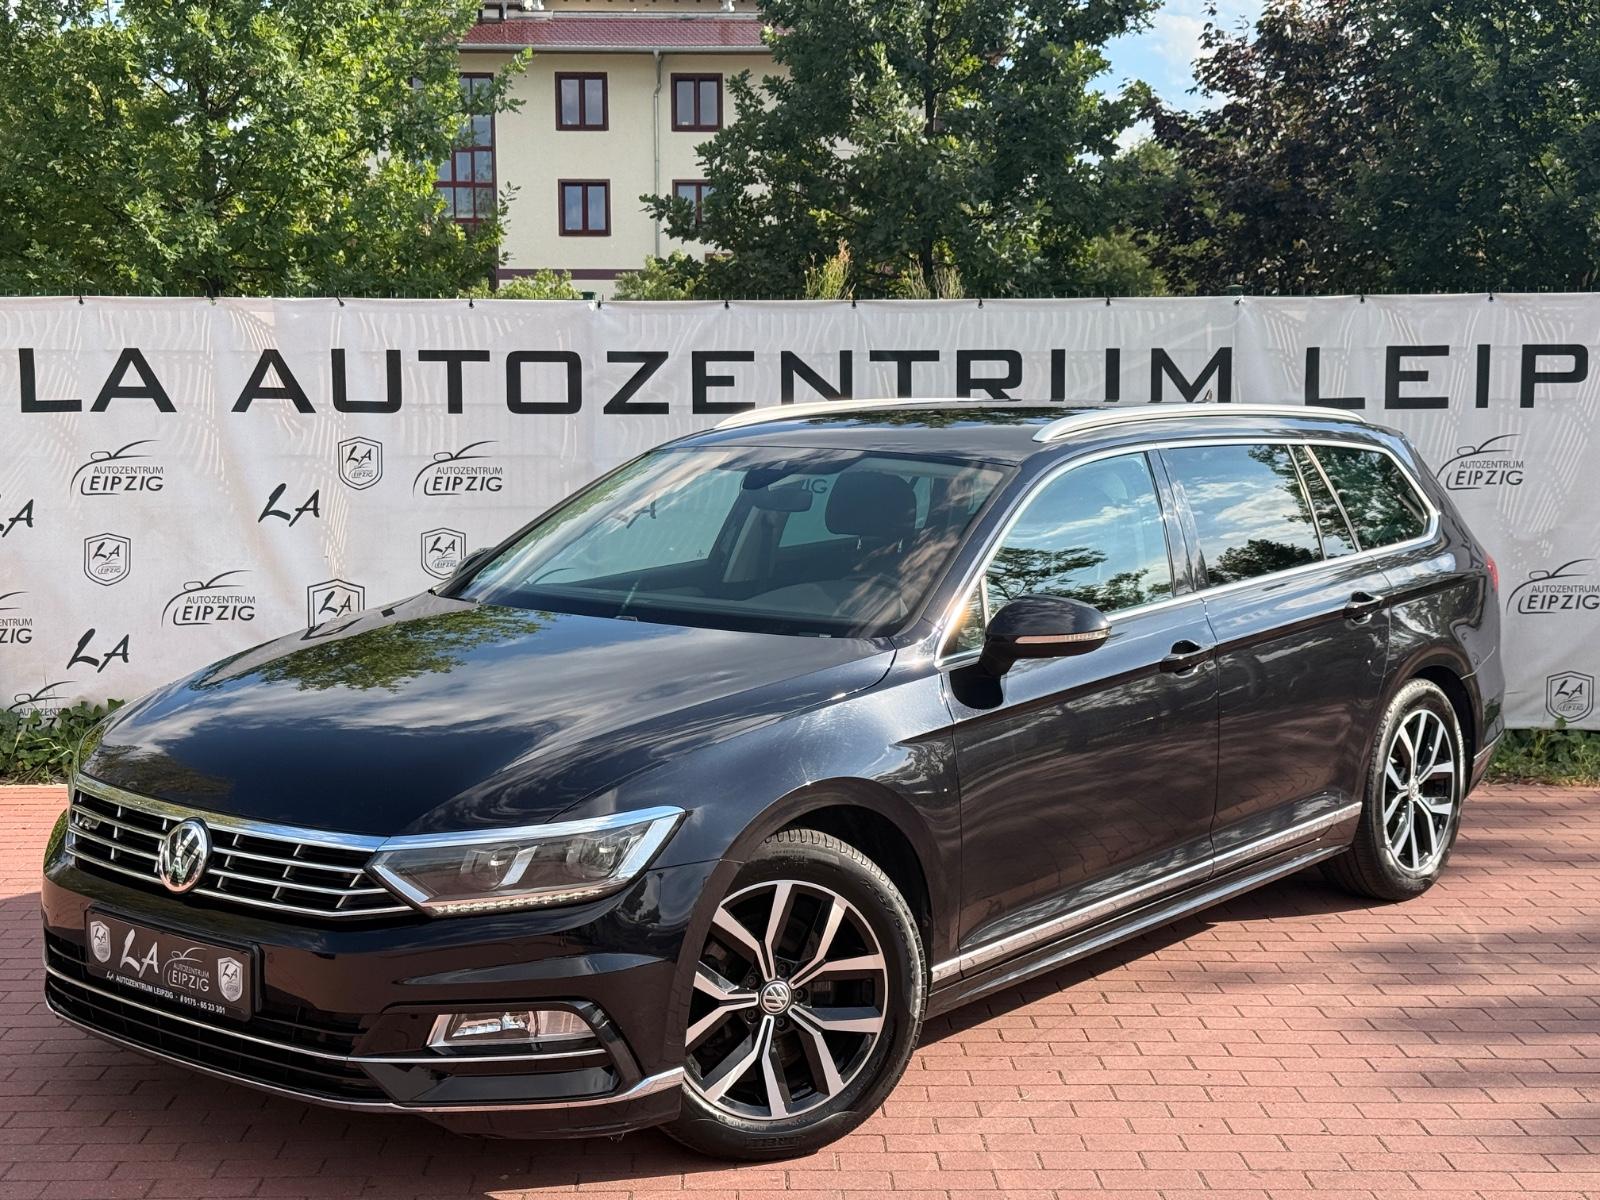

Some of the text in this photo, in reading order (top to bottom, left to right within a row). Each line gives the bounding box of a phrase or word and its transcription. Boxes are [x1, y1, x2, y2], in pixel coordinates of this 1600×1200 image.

[18, 344, 1589, 414] LA AUTOZENTRUM LEIP
[346, 445, 372, 465] LA
[1459, 460, 1524, 469] AUTOZENTRUM
[93, 466, 164, 475] AUTOZENTRUM
[436, 466, 503, 475] AUTOZENTRUM
[258, 483, 320, 527] LA
[0, 494, 34, 538] A
[92, 541, 120, 561] LA
[429, 536, 455, 556] LA
[1531, 584, 1600, 593] AUTOZENTRUM
[186, 595, 256, 604] AUTOZENTRUM
[319, 590, 352, 617] LA
[66, 628, 130, 673] LA
[1554, 679, 1583, 699] LA
[120, 928, 159, 978] LA
[116, 975, 153, 992] AUTOZENTRUM
[153, 986, 174, 999] LEIPZIG
